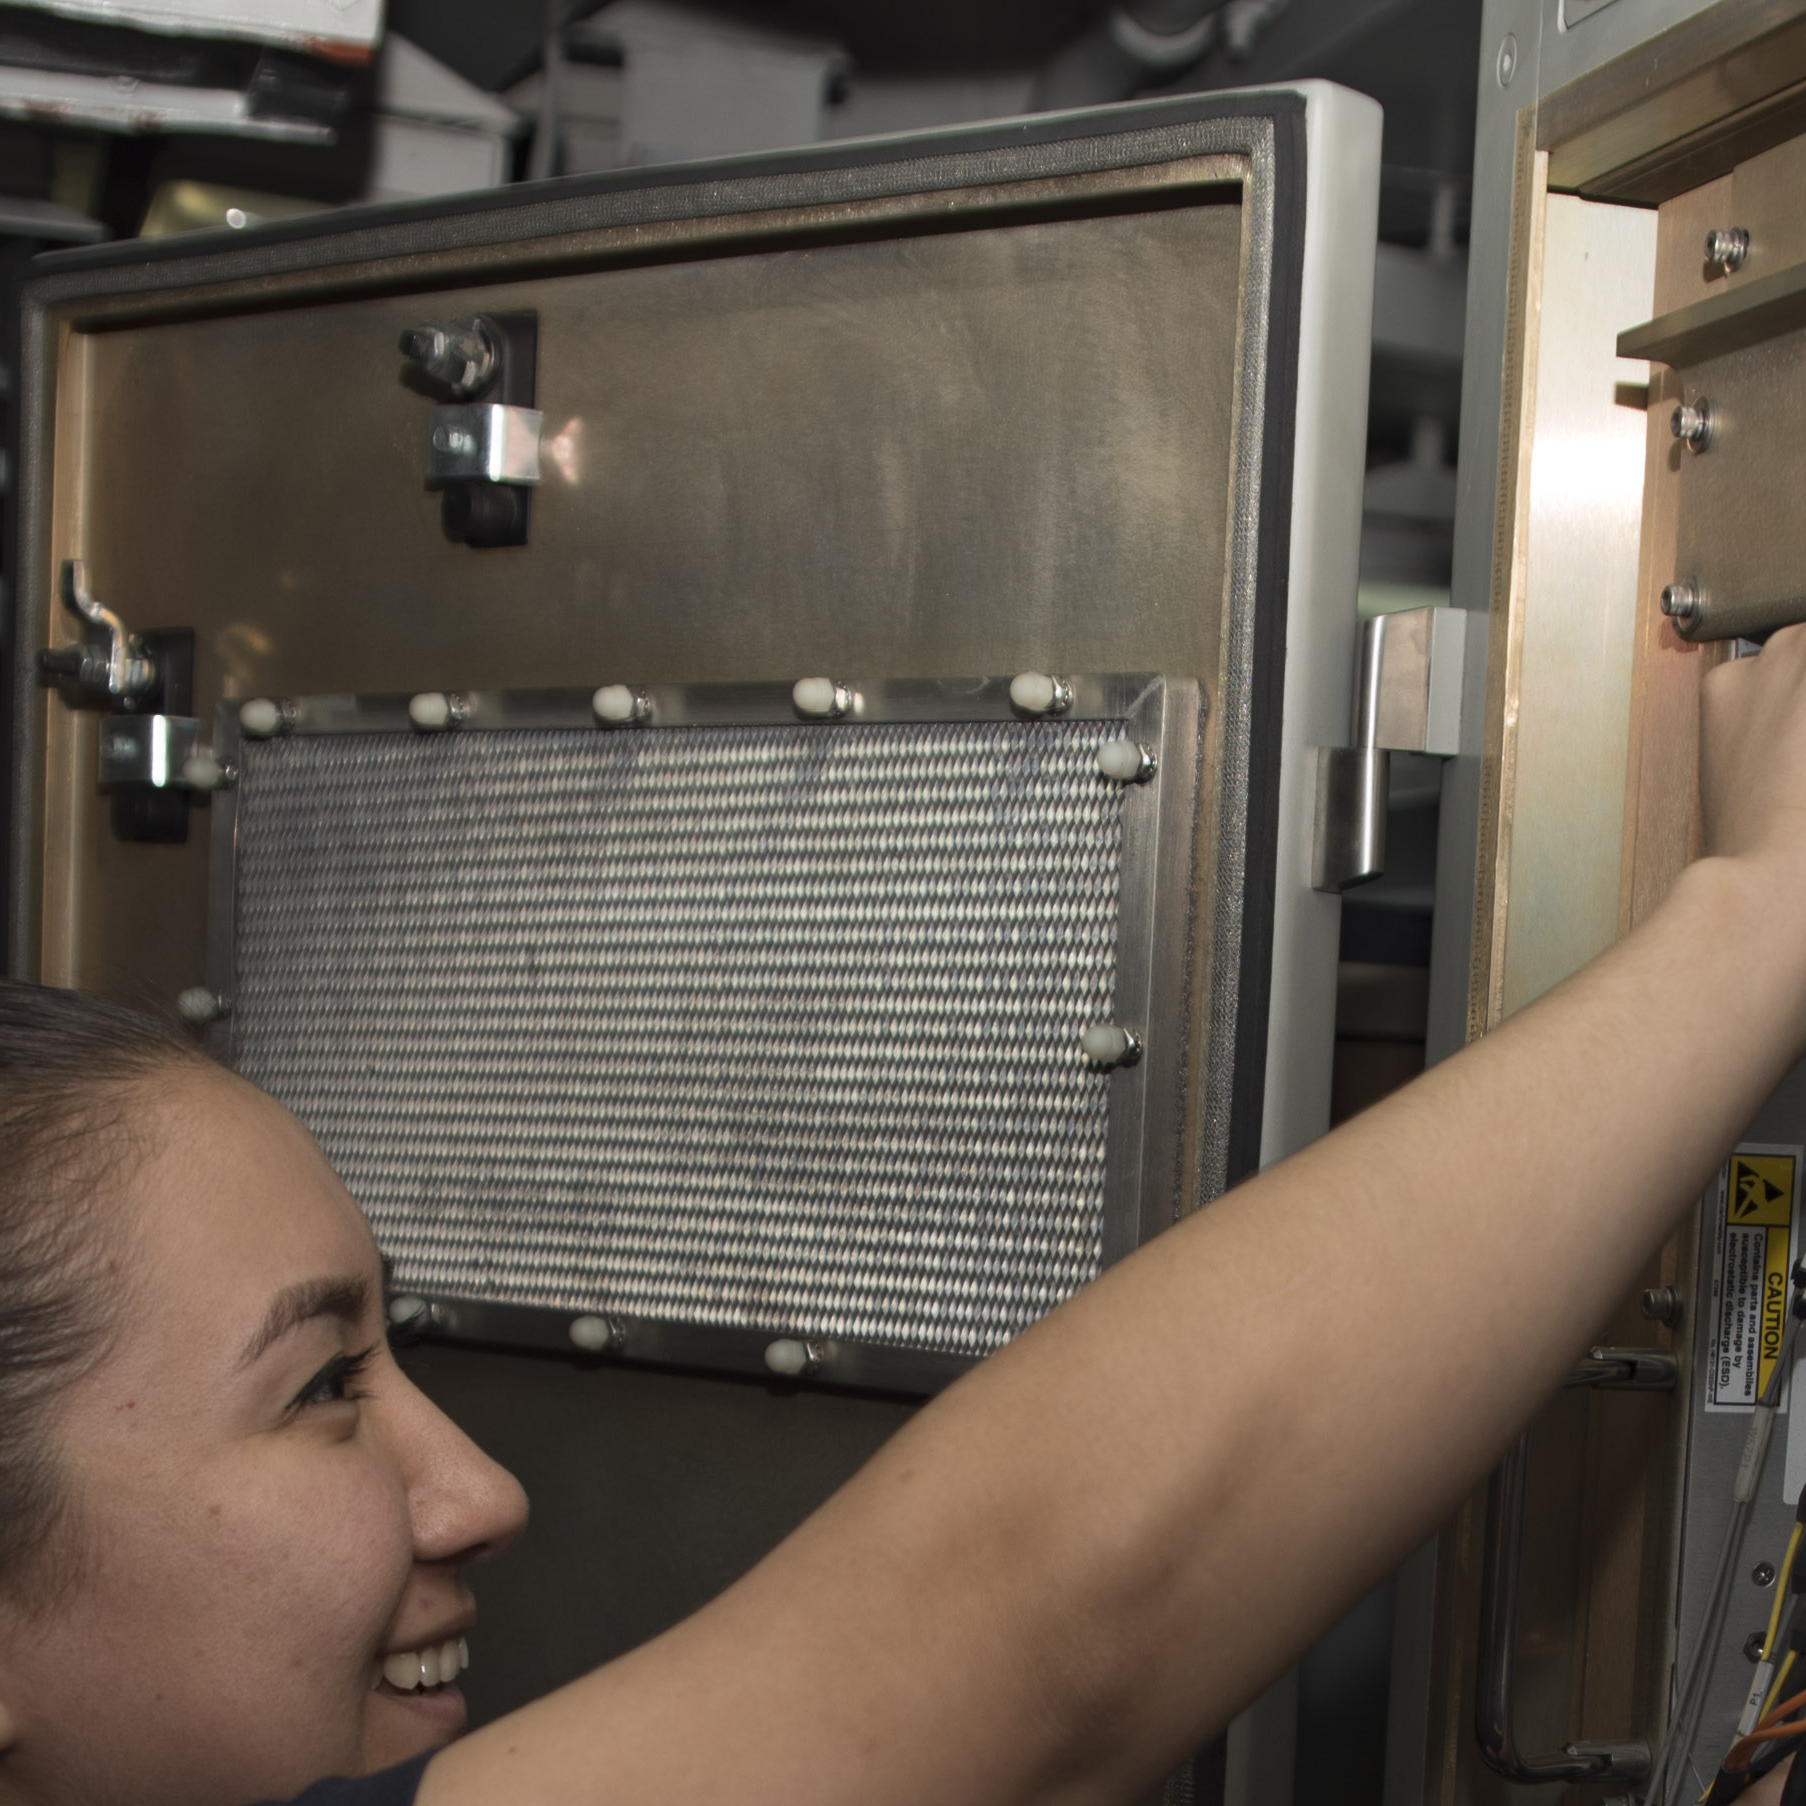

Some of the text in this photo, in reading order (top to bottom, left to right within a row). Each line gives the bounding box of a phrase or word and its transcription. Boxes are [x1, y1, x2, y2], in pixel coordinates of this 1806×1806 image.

[1725, 1233, 1738, 1298] electrostatic
[1731, 1233, 1750, 1369] susceptible to damage by
[1721, 1301, 1735, 1353] discharge
[1744, 1233, 1763, 1397] Contains parts and assemblies
[1763, 1272, 1783, 1360] CAUTION
